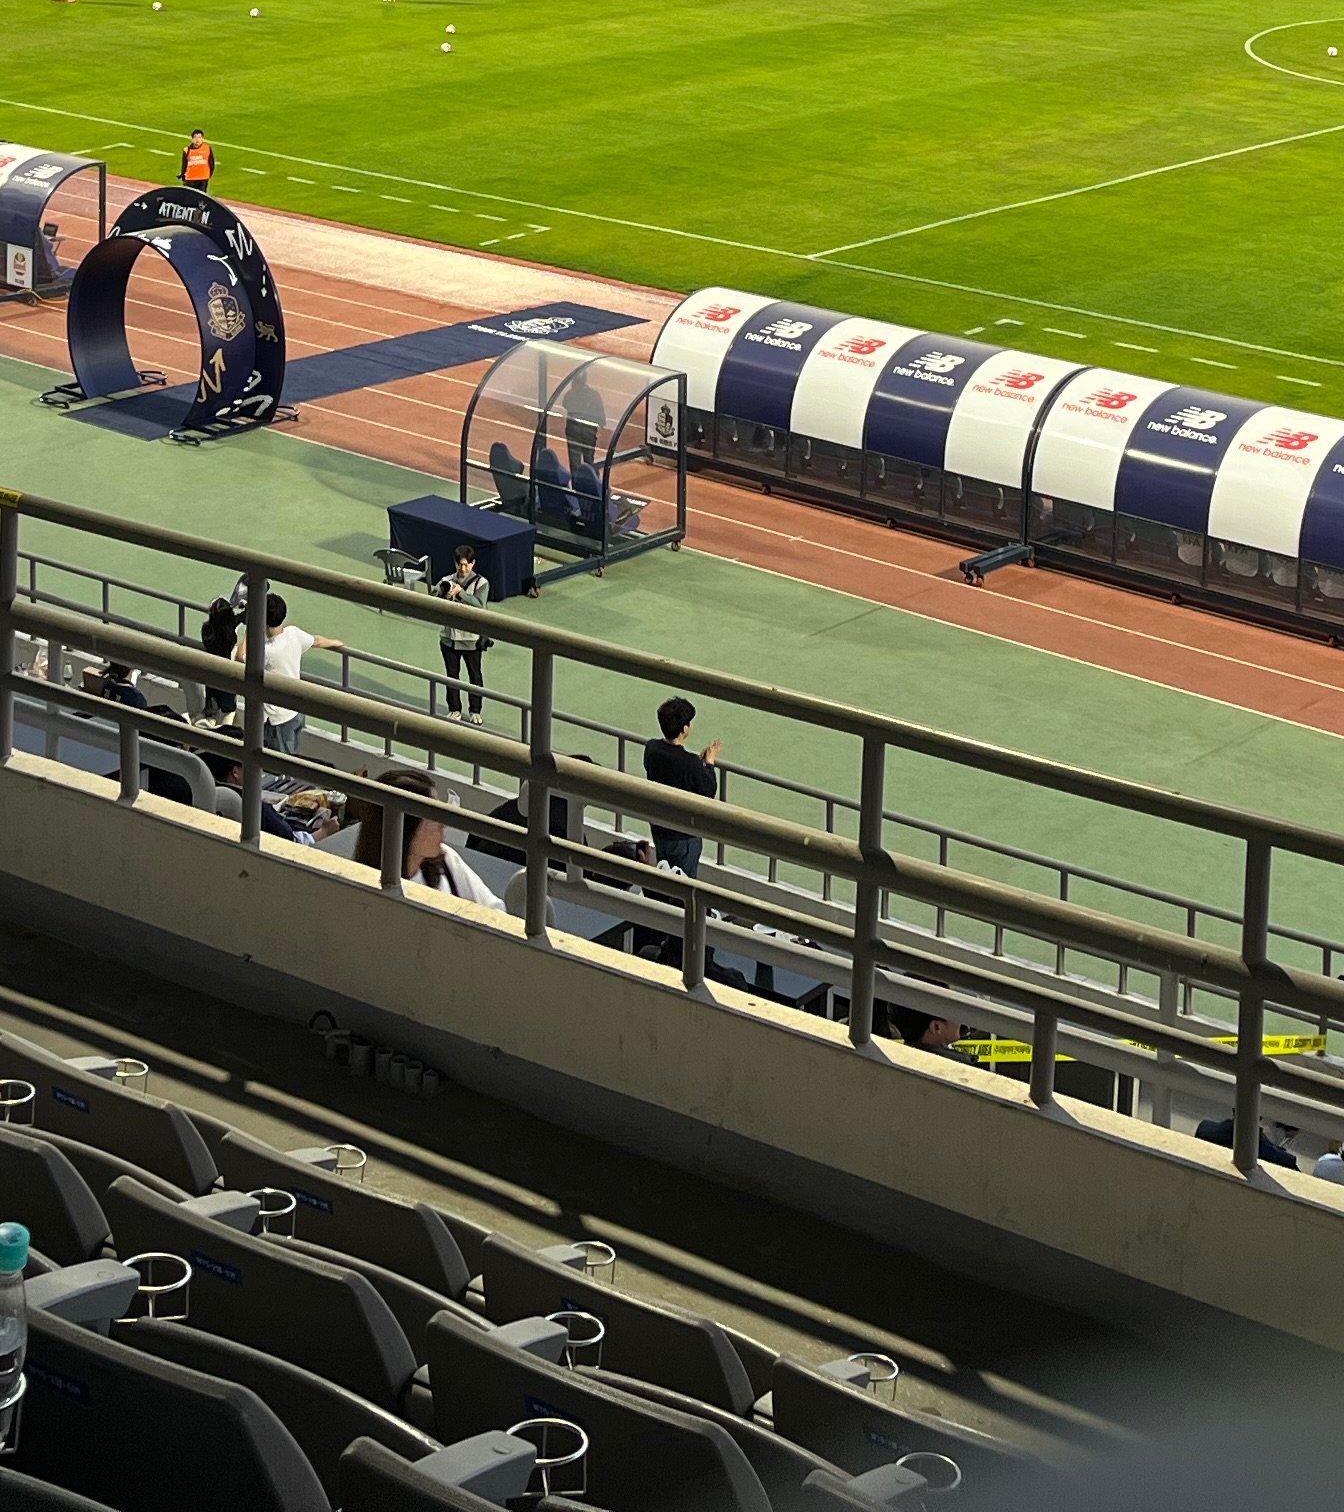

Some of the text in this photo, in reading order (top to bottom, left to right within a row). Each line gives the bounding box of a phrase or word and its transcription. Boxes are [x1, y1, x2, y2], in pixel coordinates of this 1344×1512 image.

[675, 316, 730, 335] new balance
[744, 332, 802, 352] new balance
[816, 348, 876, 368] new balance
[892, 365, 955, 387] new balance
[971, 383, 1036, 404] new balance
[1061, 401, 1129, 425] new balance
[1146, 420, 1217, 445] new balance
[1237, 441, 1312, 466] new balance
